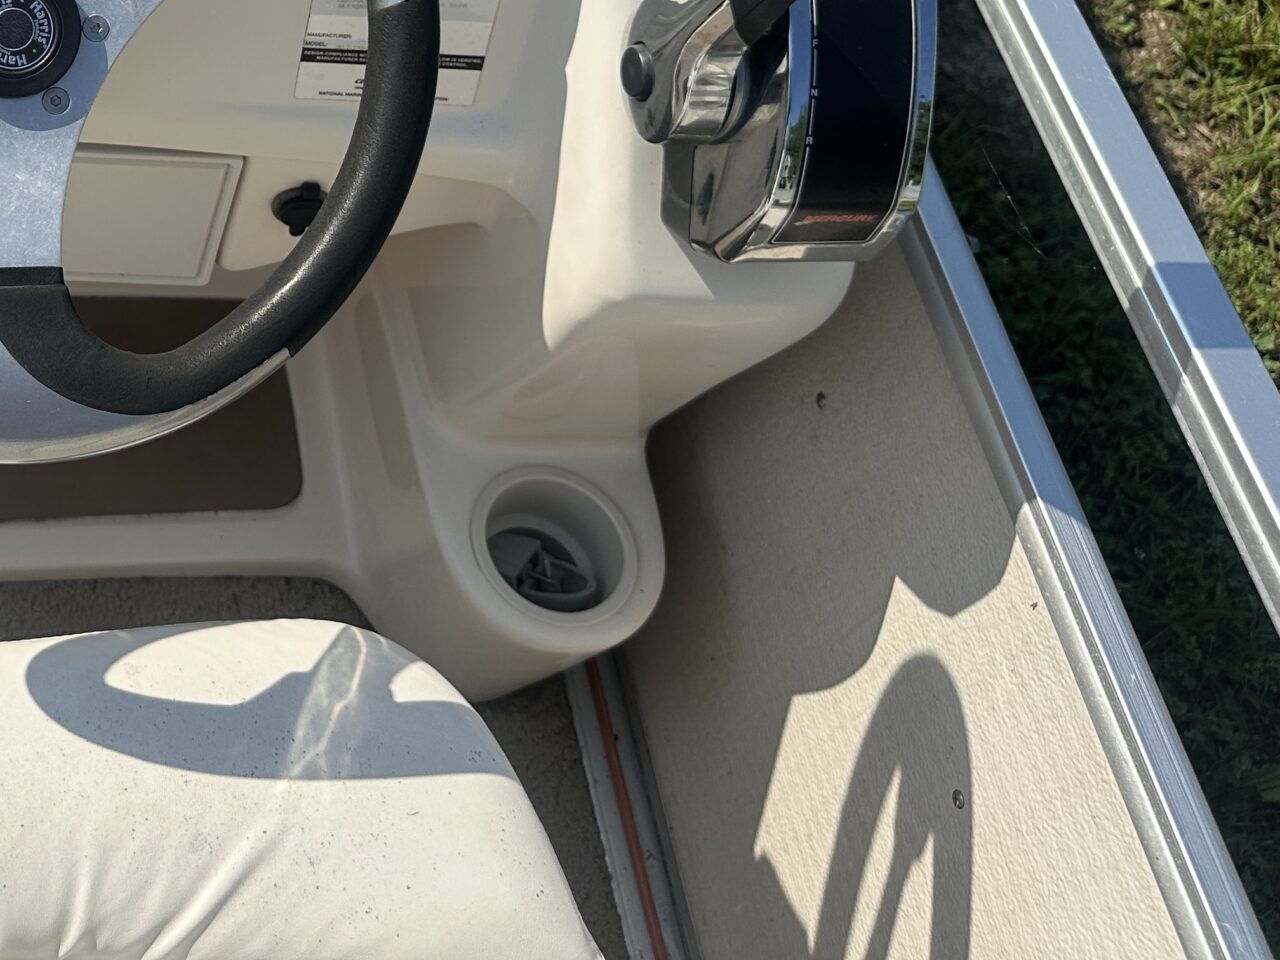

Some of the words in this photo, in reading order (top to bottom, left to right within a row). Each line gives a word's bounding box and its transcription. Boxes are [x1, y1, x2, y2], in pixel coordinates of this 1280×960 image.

[29, 0, 51, 44] Harris
[812, 39, 819, 48] F
[810, 88, 818, 97] N
[805, 136, 813, 145] R
[804, 214, 874, 223] MERCURY
